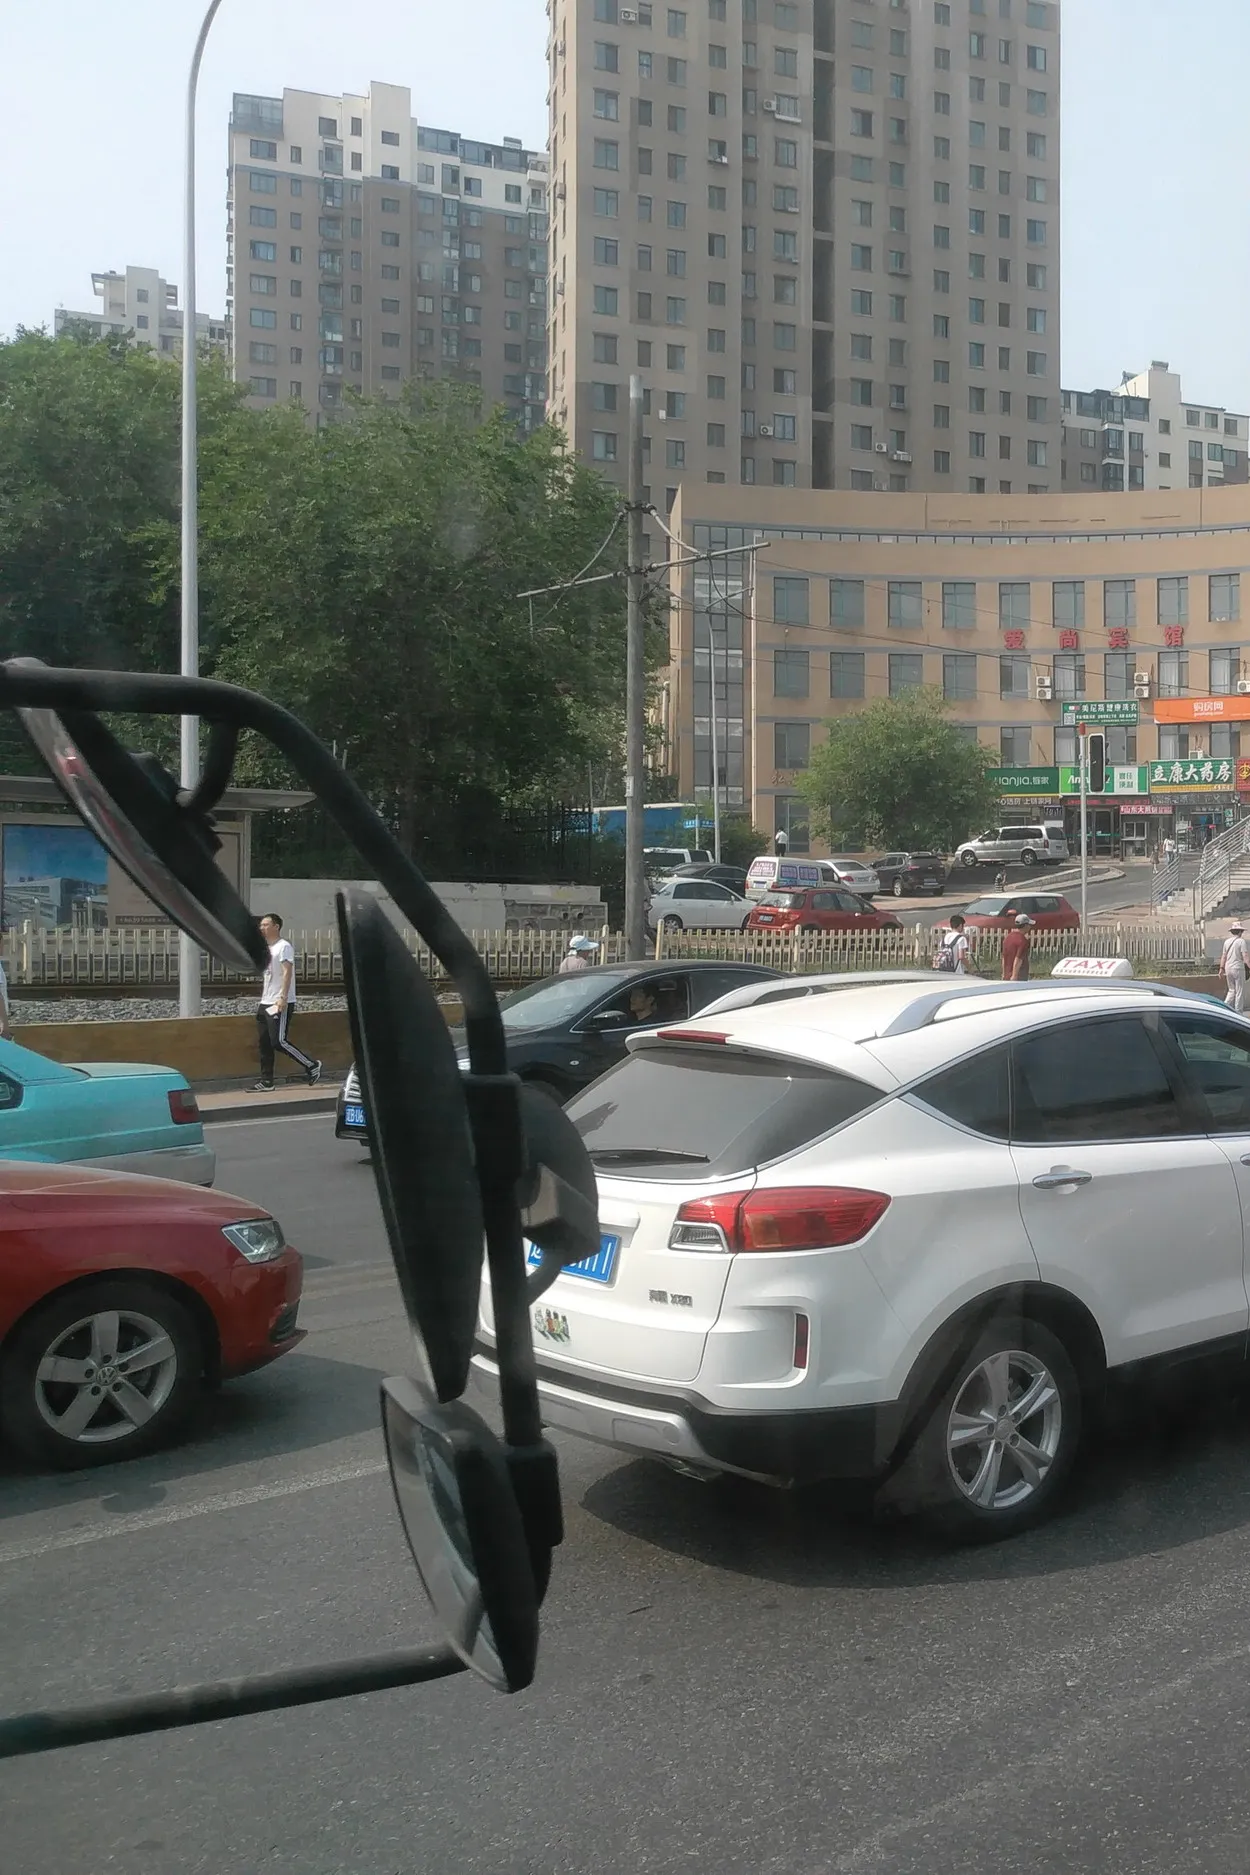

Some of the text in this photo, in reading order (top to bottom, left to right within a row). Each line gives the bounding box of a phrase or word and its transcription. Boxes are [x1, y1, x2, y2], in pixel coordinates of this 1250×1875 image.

[1004, 625, 1184, 650] 爱尚宾馆
[1151, 761, 1232, 784] 立康大药房
[1063, 959, 1116, 969] TAXI
